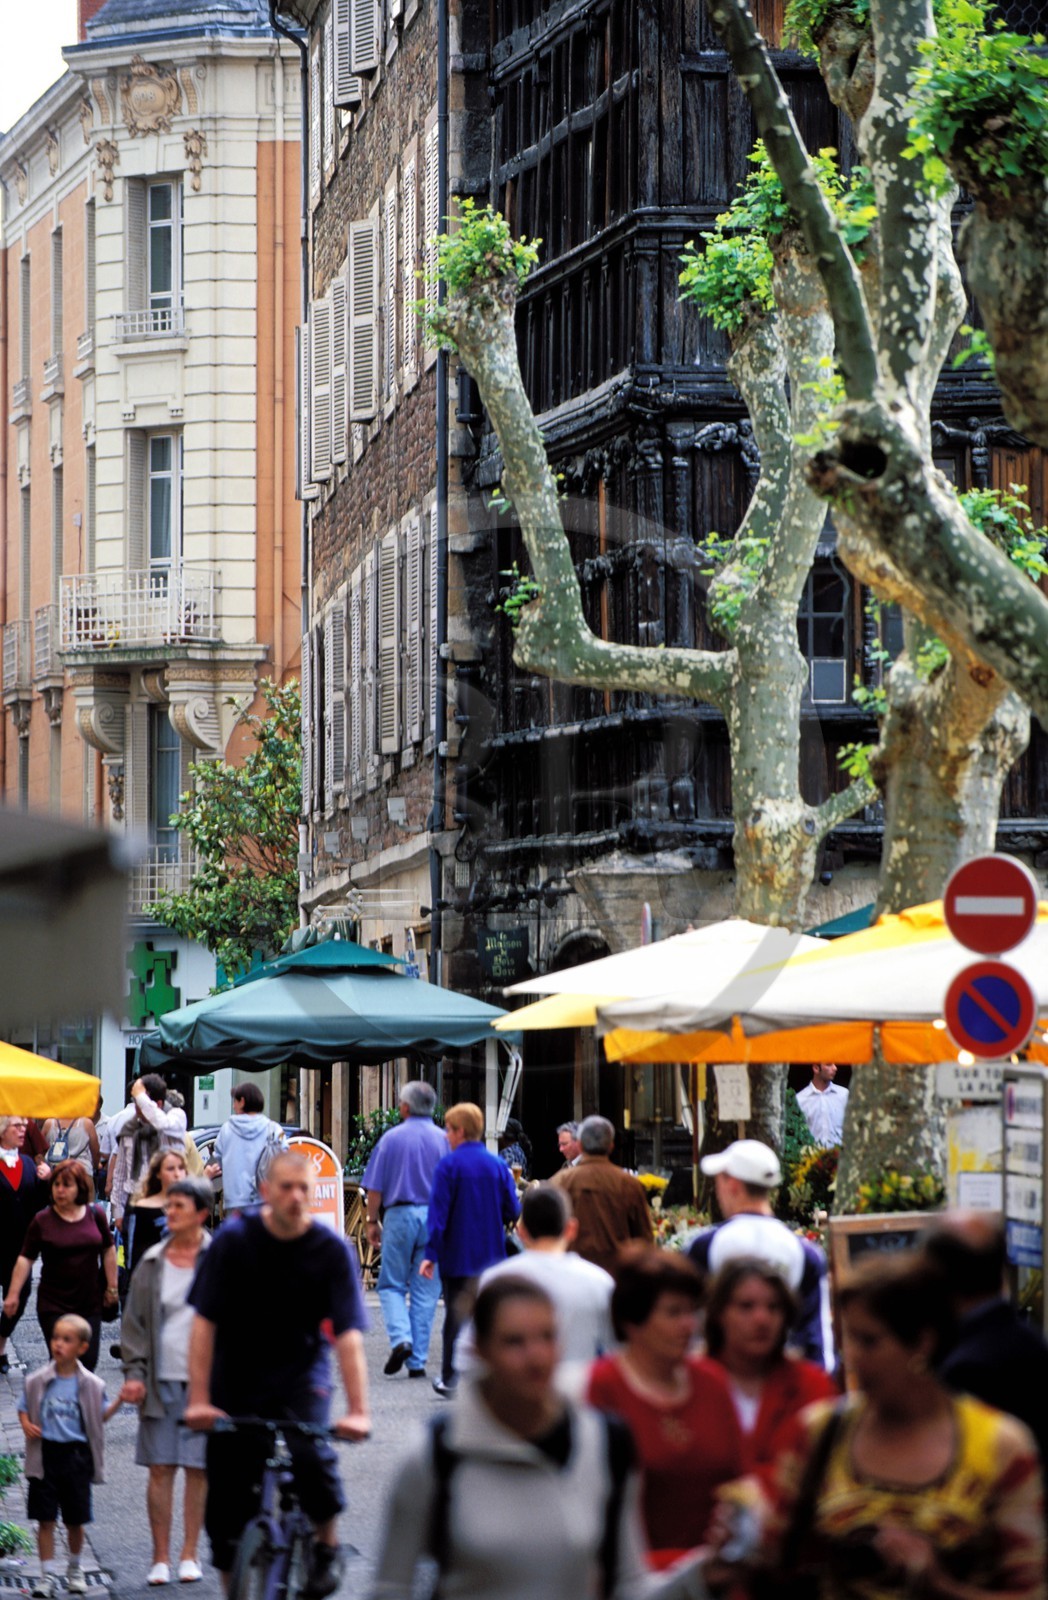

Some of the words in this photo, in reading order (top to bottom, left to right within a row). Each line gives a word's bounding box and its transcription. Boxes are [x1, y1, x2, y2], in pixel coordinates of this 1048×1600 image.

[485, 936, 522, 951] Maison
[954, 1069, 979, 1079] SUR
[985, 1069, 1003, 1079] TO
[958, 1083, 973, 1093] LA
[979, 1083, 1004, 1093] PLA
[315, 1184, 335, 1198] ANT
